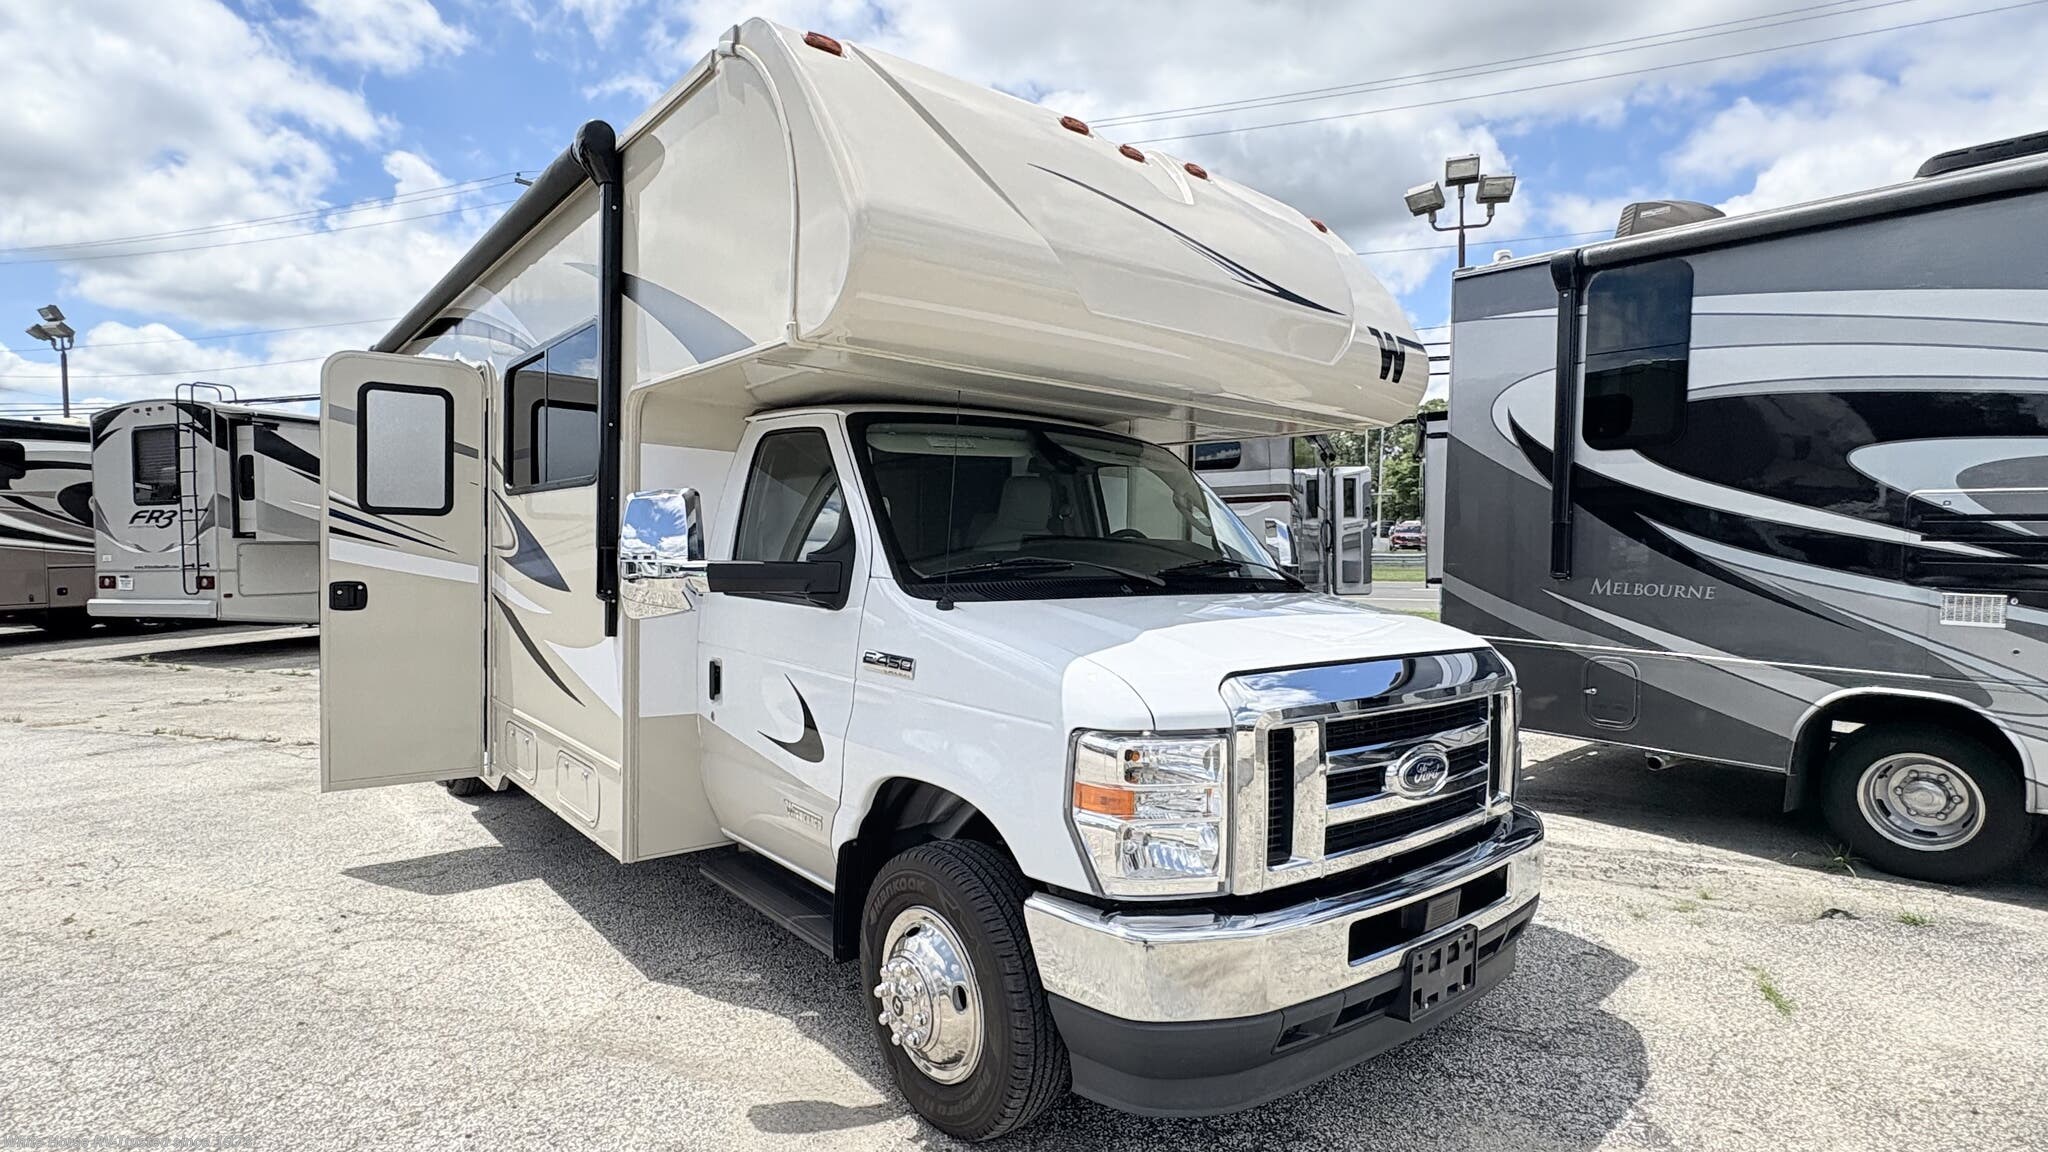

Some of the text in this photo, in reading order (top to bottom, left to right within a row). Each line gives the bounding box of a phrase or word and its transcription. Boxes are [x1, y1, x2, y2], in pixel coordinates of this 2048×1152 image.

[128, 509, 178, 529] FR3
[1589, 577, 1717, 600] MELBOURNE
[1414, 762, 1440, 784] Ford
